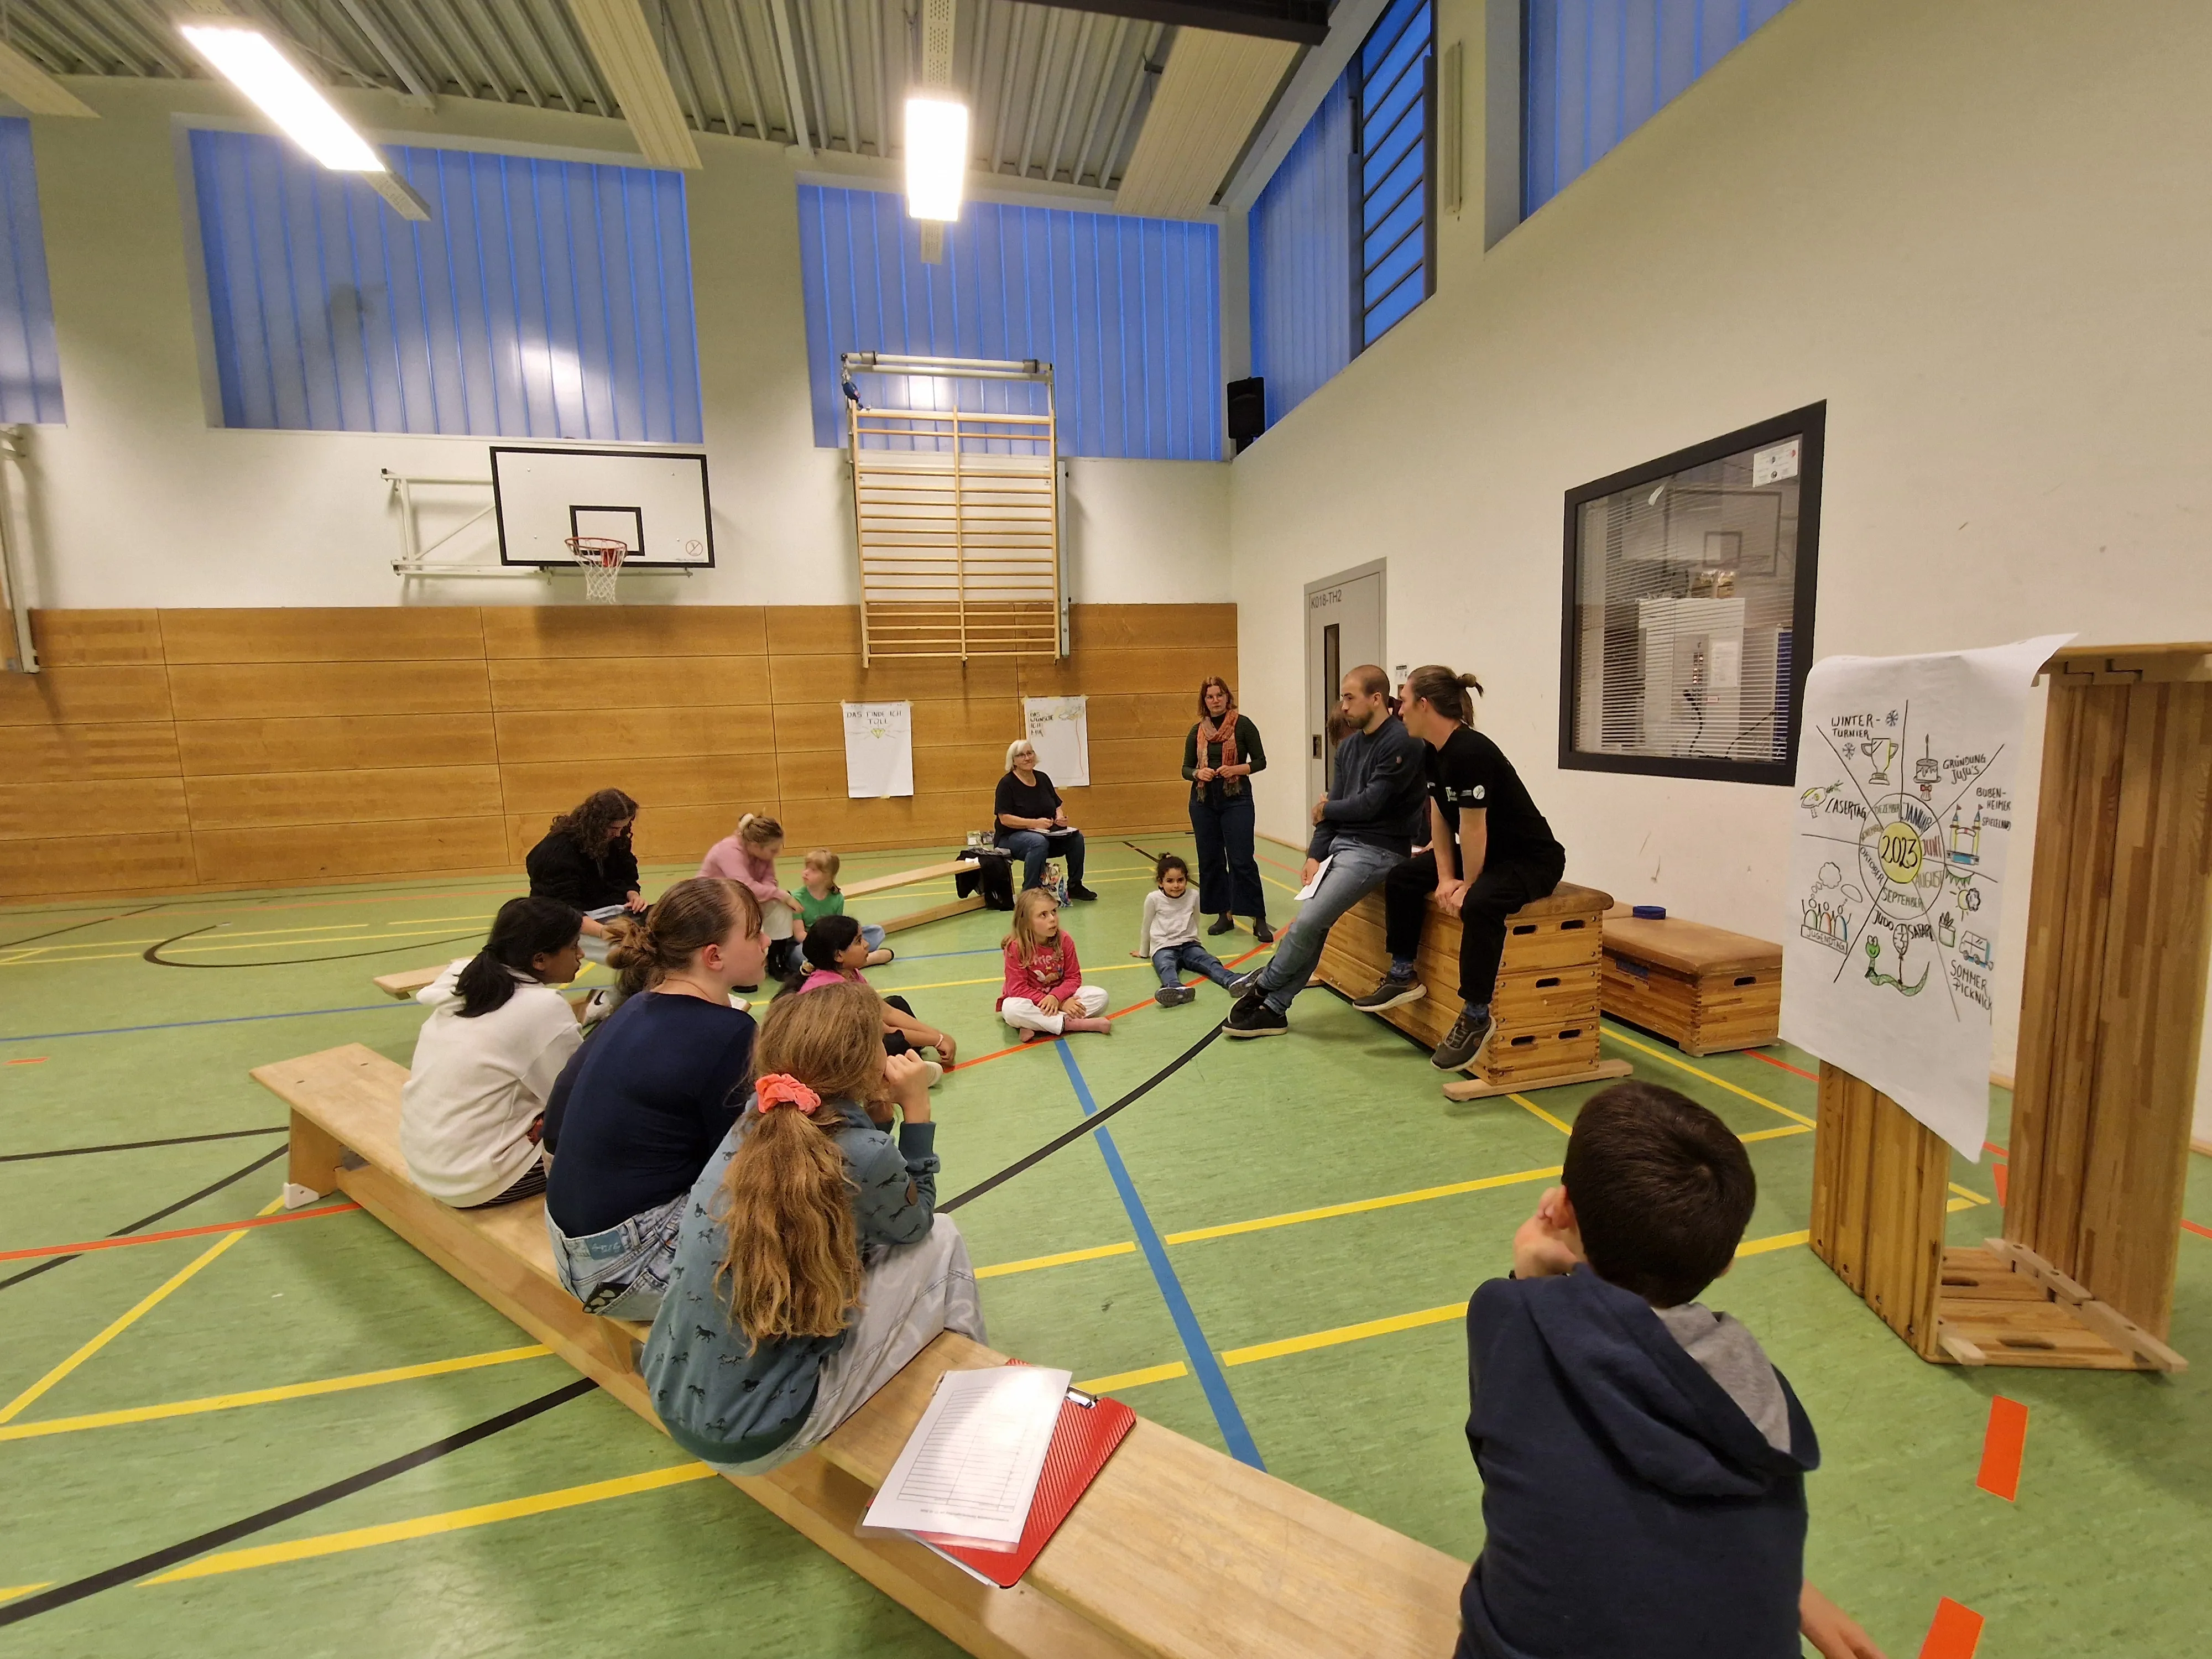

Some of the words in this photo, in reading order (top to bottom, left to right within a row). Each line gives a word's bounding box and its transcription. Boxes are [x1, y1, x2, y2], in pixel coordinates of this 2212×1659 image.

[1311, 589, 1342, 609] K018-TH2
[1832, 728, 1871, 741] TURNIER
[1943, 753, 1986, 770] GRÜNDUNG
[1825, 797, 1867, 822] LASERTAG
[1874, 803, 1901, 818] DEZEMBER
[1901, 802, 1932, 833] JANUAR
[1986, 800, 2011, 811] HEIMER
[1881, 835, 1918, 869] 2023
[1860, 847, 1885, 886] OKTOBER
[1915, 870, 1943, 889] AUGUST
[1881, 886, 1924, 911] SEPTEMBER
[1872, 909, 1894, 931] JUDO
[1907, 923, 1935, 942] SAFARI
[1806, 928, 1845, 952] JUGENDTAG
[1950, 959, 1988, 999] SOMMER
[1953, 977, 1992, 1023] PICKNICK
